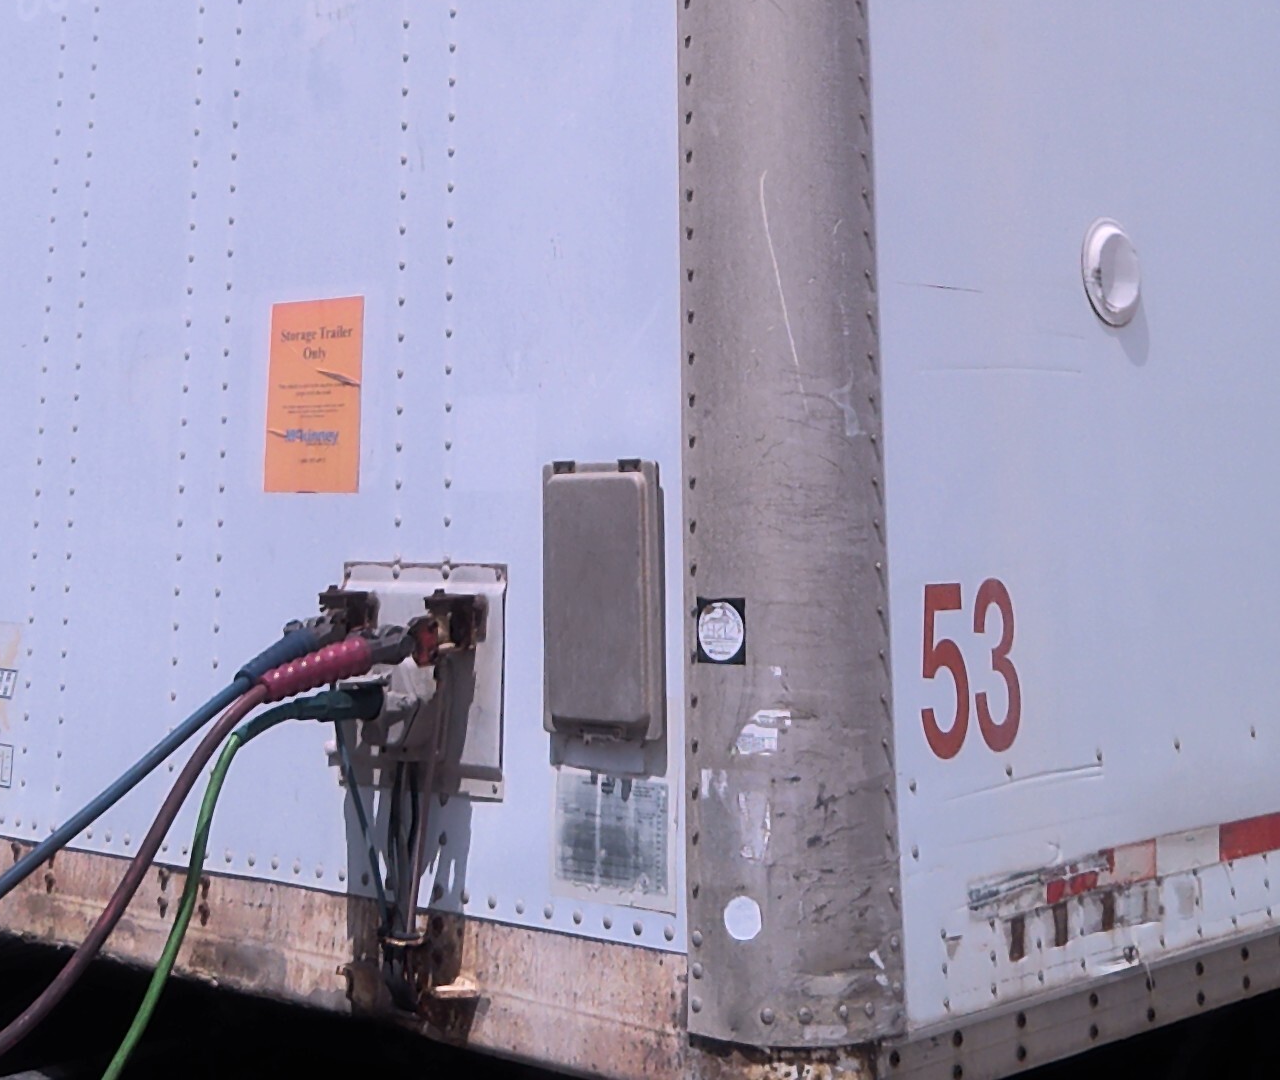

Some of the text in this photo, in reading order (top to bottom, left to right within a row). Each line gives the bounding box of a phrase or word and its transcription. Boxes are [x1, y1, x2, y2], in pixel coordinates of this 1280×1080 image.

[281, 325, 353, 345] Storage Trailer
[303, 346, 327, 362] Only
[921, 577, 1021, 760] 53
